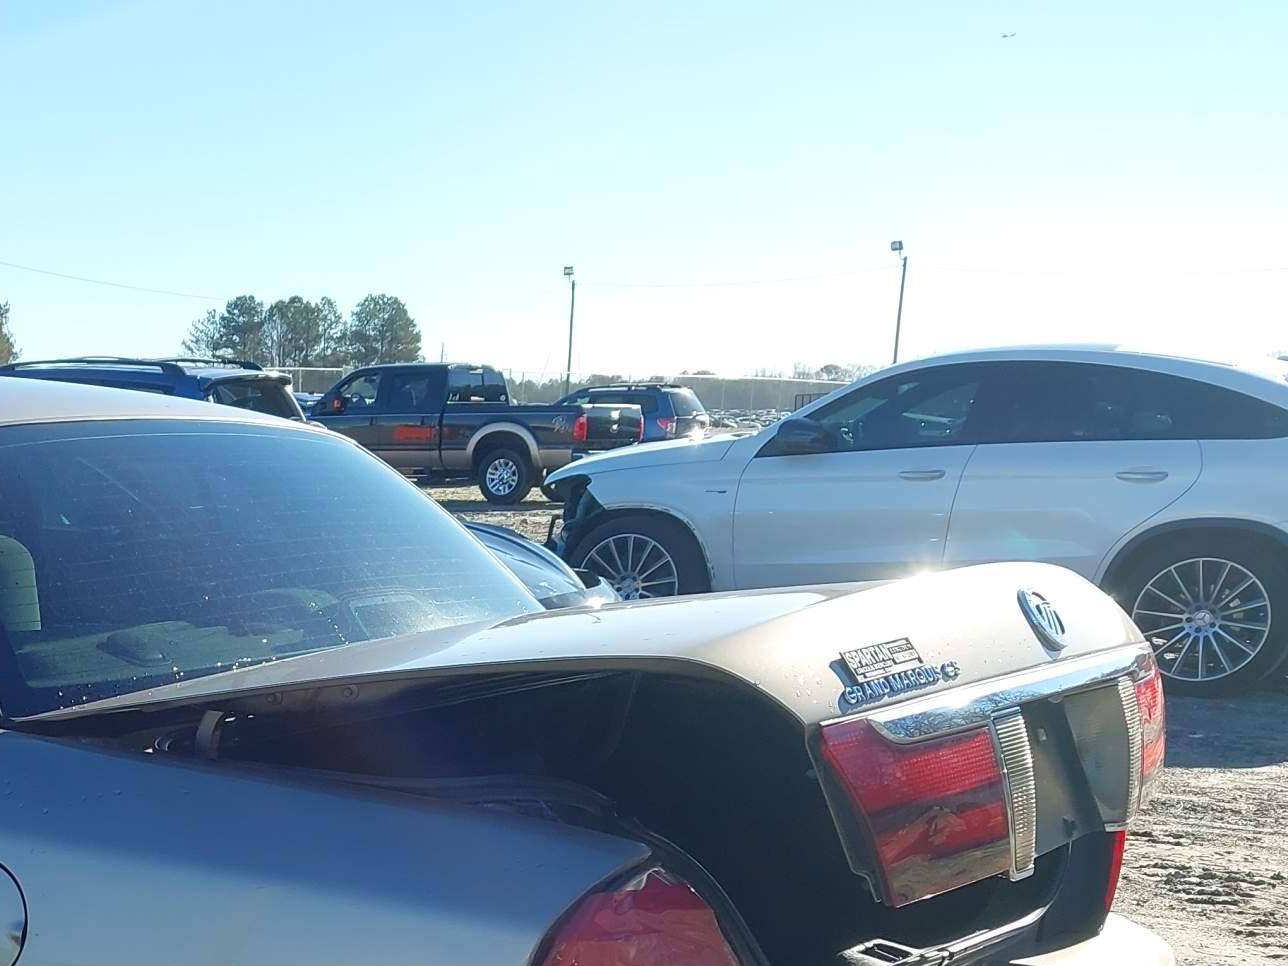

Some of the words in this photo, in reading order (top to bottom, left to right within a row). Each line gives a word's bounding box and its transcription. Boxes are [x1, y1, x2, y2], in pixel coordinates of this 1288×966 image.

[845, 643, 893, 668] SPARTAN
[845, 679, 890, 704] GRAND
[889, 664, 943, 694] MARQUIS
